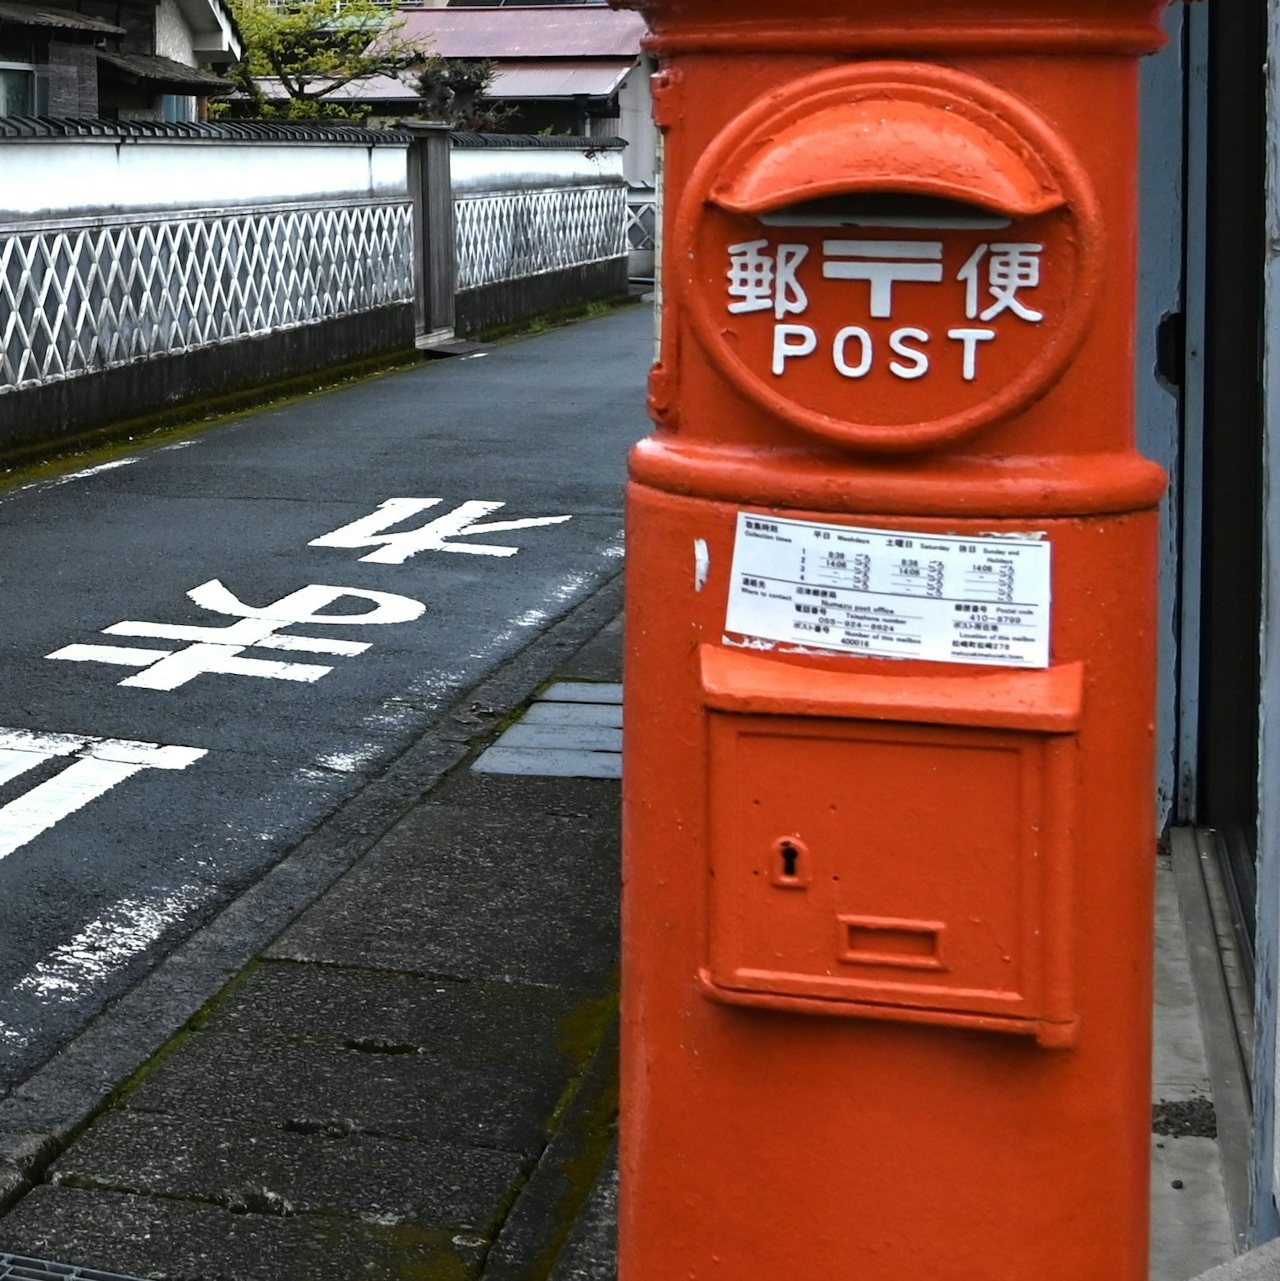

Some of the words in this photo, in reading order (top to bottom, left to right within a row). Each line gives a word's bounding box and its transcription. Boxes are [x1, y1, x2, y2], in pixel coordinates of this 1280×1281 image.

[772, 324, 996, 381] POST
[746, 521, 778, 532] 取集時刻
[745, 531, 774, 540] Collection
[814, 530, 830, 539] 平日
[837, 536, 870, 544] Weekdays
[885, 539, 913, 548] 土曜日
[920, 543, 950, 552] Saturday
[959, 545, 976, 553] 休日
[983, 548, 1005, 556] Sunday
[987, 557, 1013, 565] Holidays
[741, 588, 759, 596] Where
[769, 592, 792, 601] contact
[795, 604, 827, 616] 電話番号
[821, 599, 852, 610] Numazu
[854, 604, 871, 613] post
[873, 606, 894, 614] office
[954, 603, 987, 613] 郵便番号
[996, 607, 1017, 615] Postal
[846, 612, 879, 623] Telephone
[881, 617, 906, 625] number
[793, 622, 830, 634] ポスト番号
[845, 630, 870, 640] Number
[881, 634, 894, 642] this
[896, 635, 921, 644] mailbox
